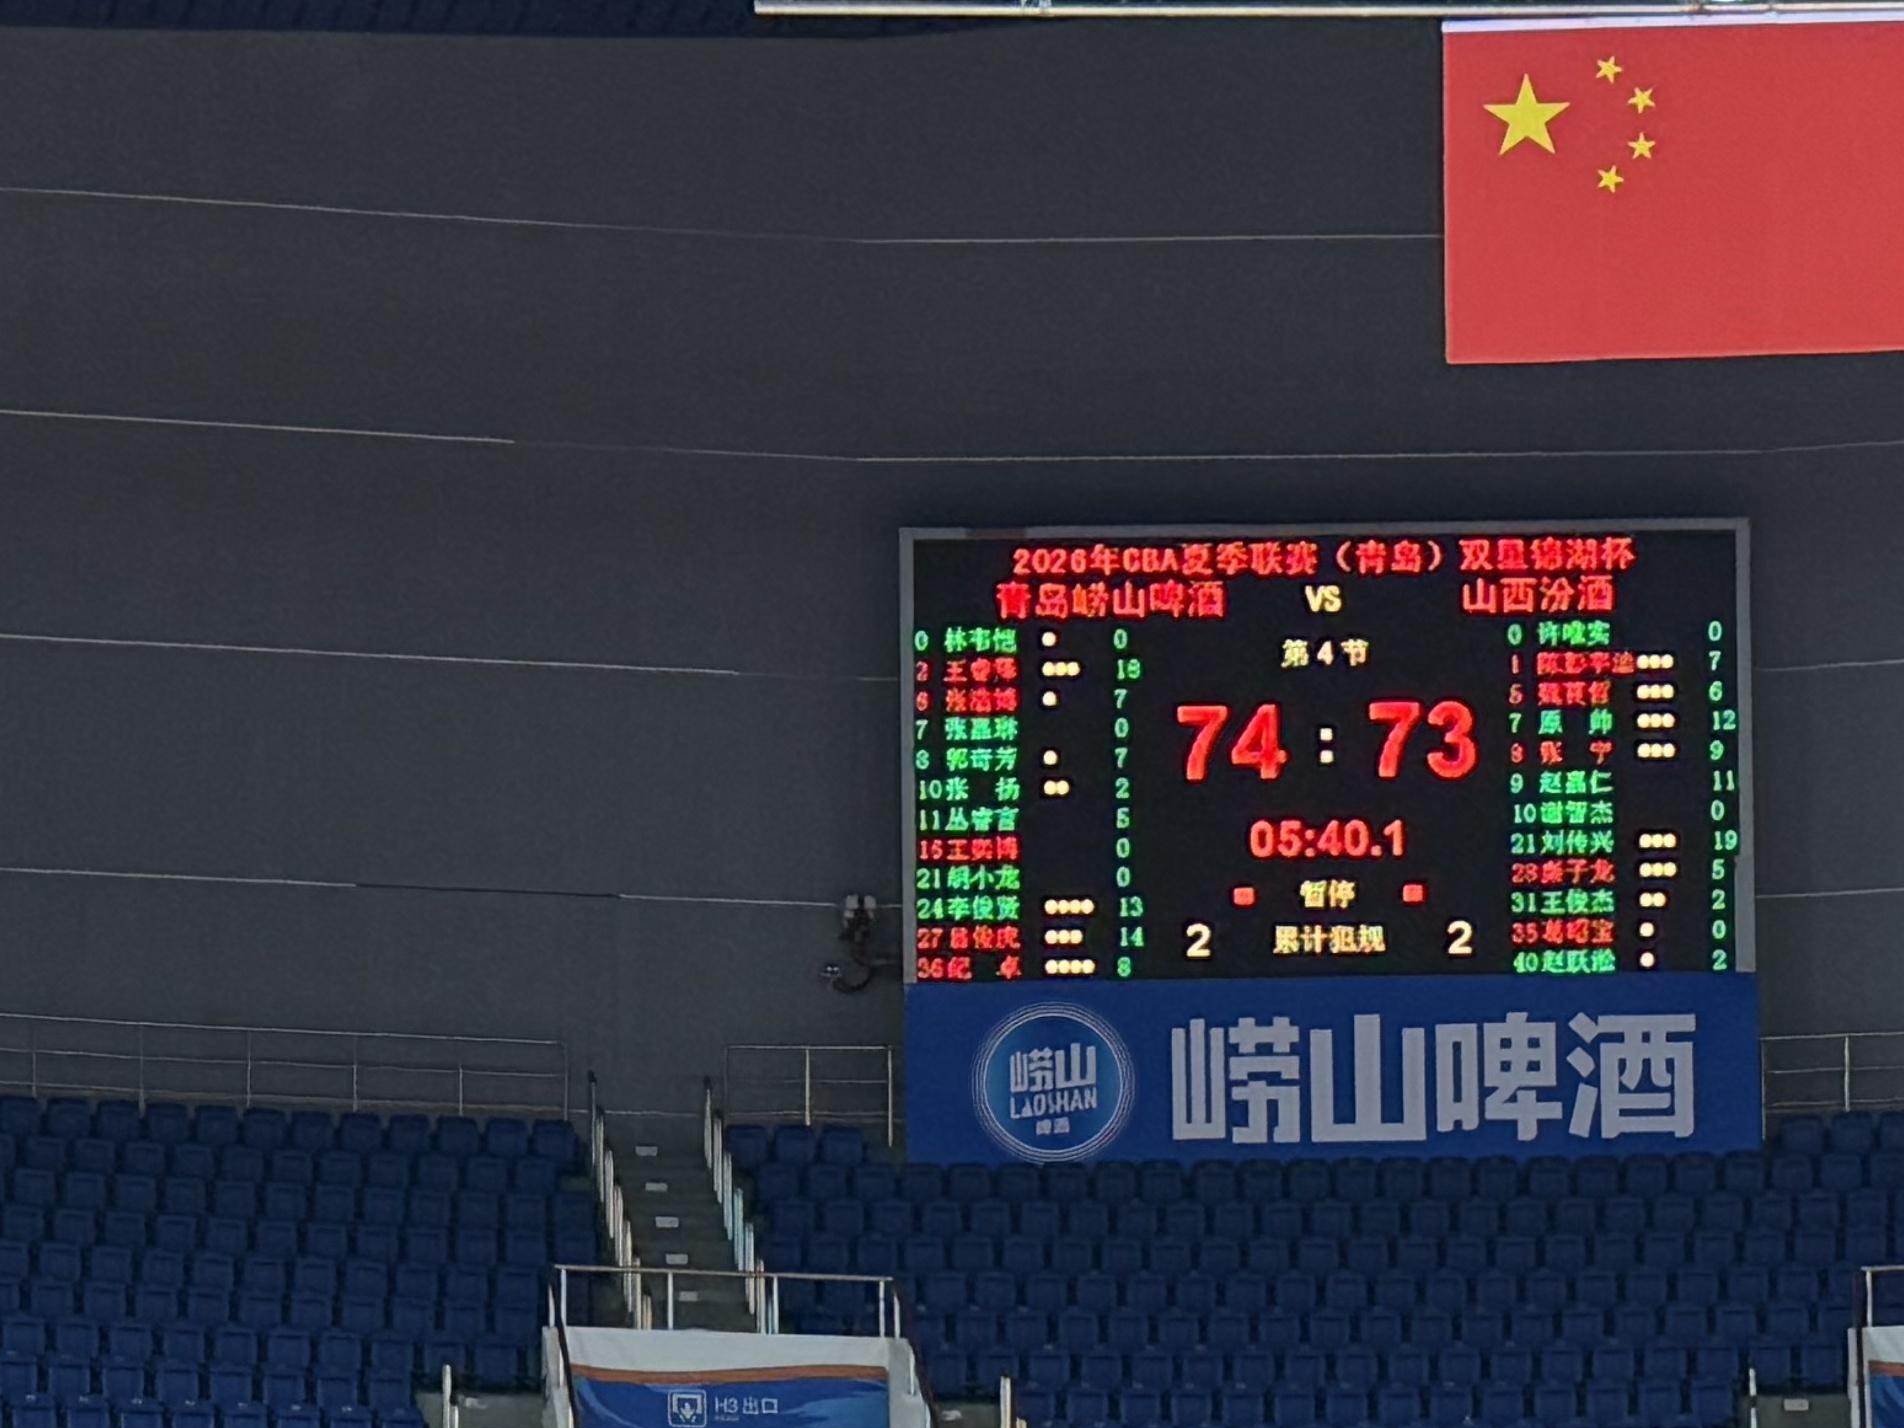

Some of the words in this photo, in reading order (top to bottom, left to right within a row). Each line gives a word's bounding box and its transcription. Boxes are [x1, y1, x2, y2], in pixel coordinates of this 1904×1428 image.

[997, 581, 1224, 619] 青岛崂山啤酒
[1304, 585, 1342, 612] VS
[1462, 575, 1613, 613] 山西汾酒
[1113, 629, 1128, 649] 0
[1708, 621, 1722, 641] 0
[1708, 650, 1721, 671] 7
[1114, 689, 1128, 709] 7
[1709, 680, 1723, 701] 6
[1114, 718, 1128, 738] 0
[1713, 709, 1737, 731] 12
[1177, 704, 1288, 780] 74
[1368, 701, 1477, 778] 73
[1709, 740, 1724, 761] 9
[1115, 747, 1128, 768] 7
[1115, 778, 1130, 799] 2
[1713, 770, 1735, 791] 11
[1711, 800, 1725, 821] 0
[1116, 838, 1130, 858] 0
[1250, 819, 1404, 858] 05:40.1
[1714, 830, 1738, 851] 19
[1116, 866, 1131, 887] 0
[1712, 859, 1725, 880] 5
[1300, 879, 1356, 909] 暂停
[1712, 889, 1726, 910] 2
[1120, 896, 1144, 918] 13
[1120, 926, 1144, 947] 14
[1186, 923, 1212, 957] 2
[1273, 924, 1386, 954] 累计犯规
[1447, 920, 1473, 955] 2
[1712, 920, 1726, 940] 0
[1117, 956, 1132, 977] 8
[1712, 949, 1727, 971] 2
[1010, 1042, 1096, 1093] 崂山
[1171, 1011, 1696, 1144] 崂山啤酒
[1010, 1087, 1097, 1120] LAOSHAN
[714, 1396, 739, 1413] H3
[742, 1396, 779, 1415] 出口
